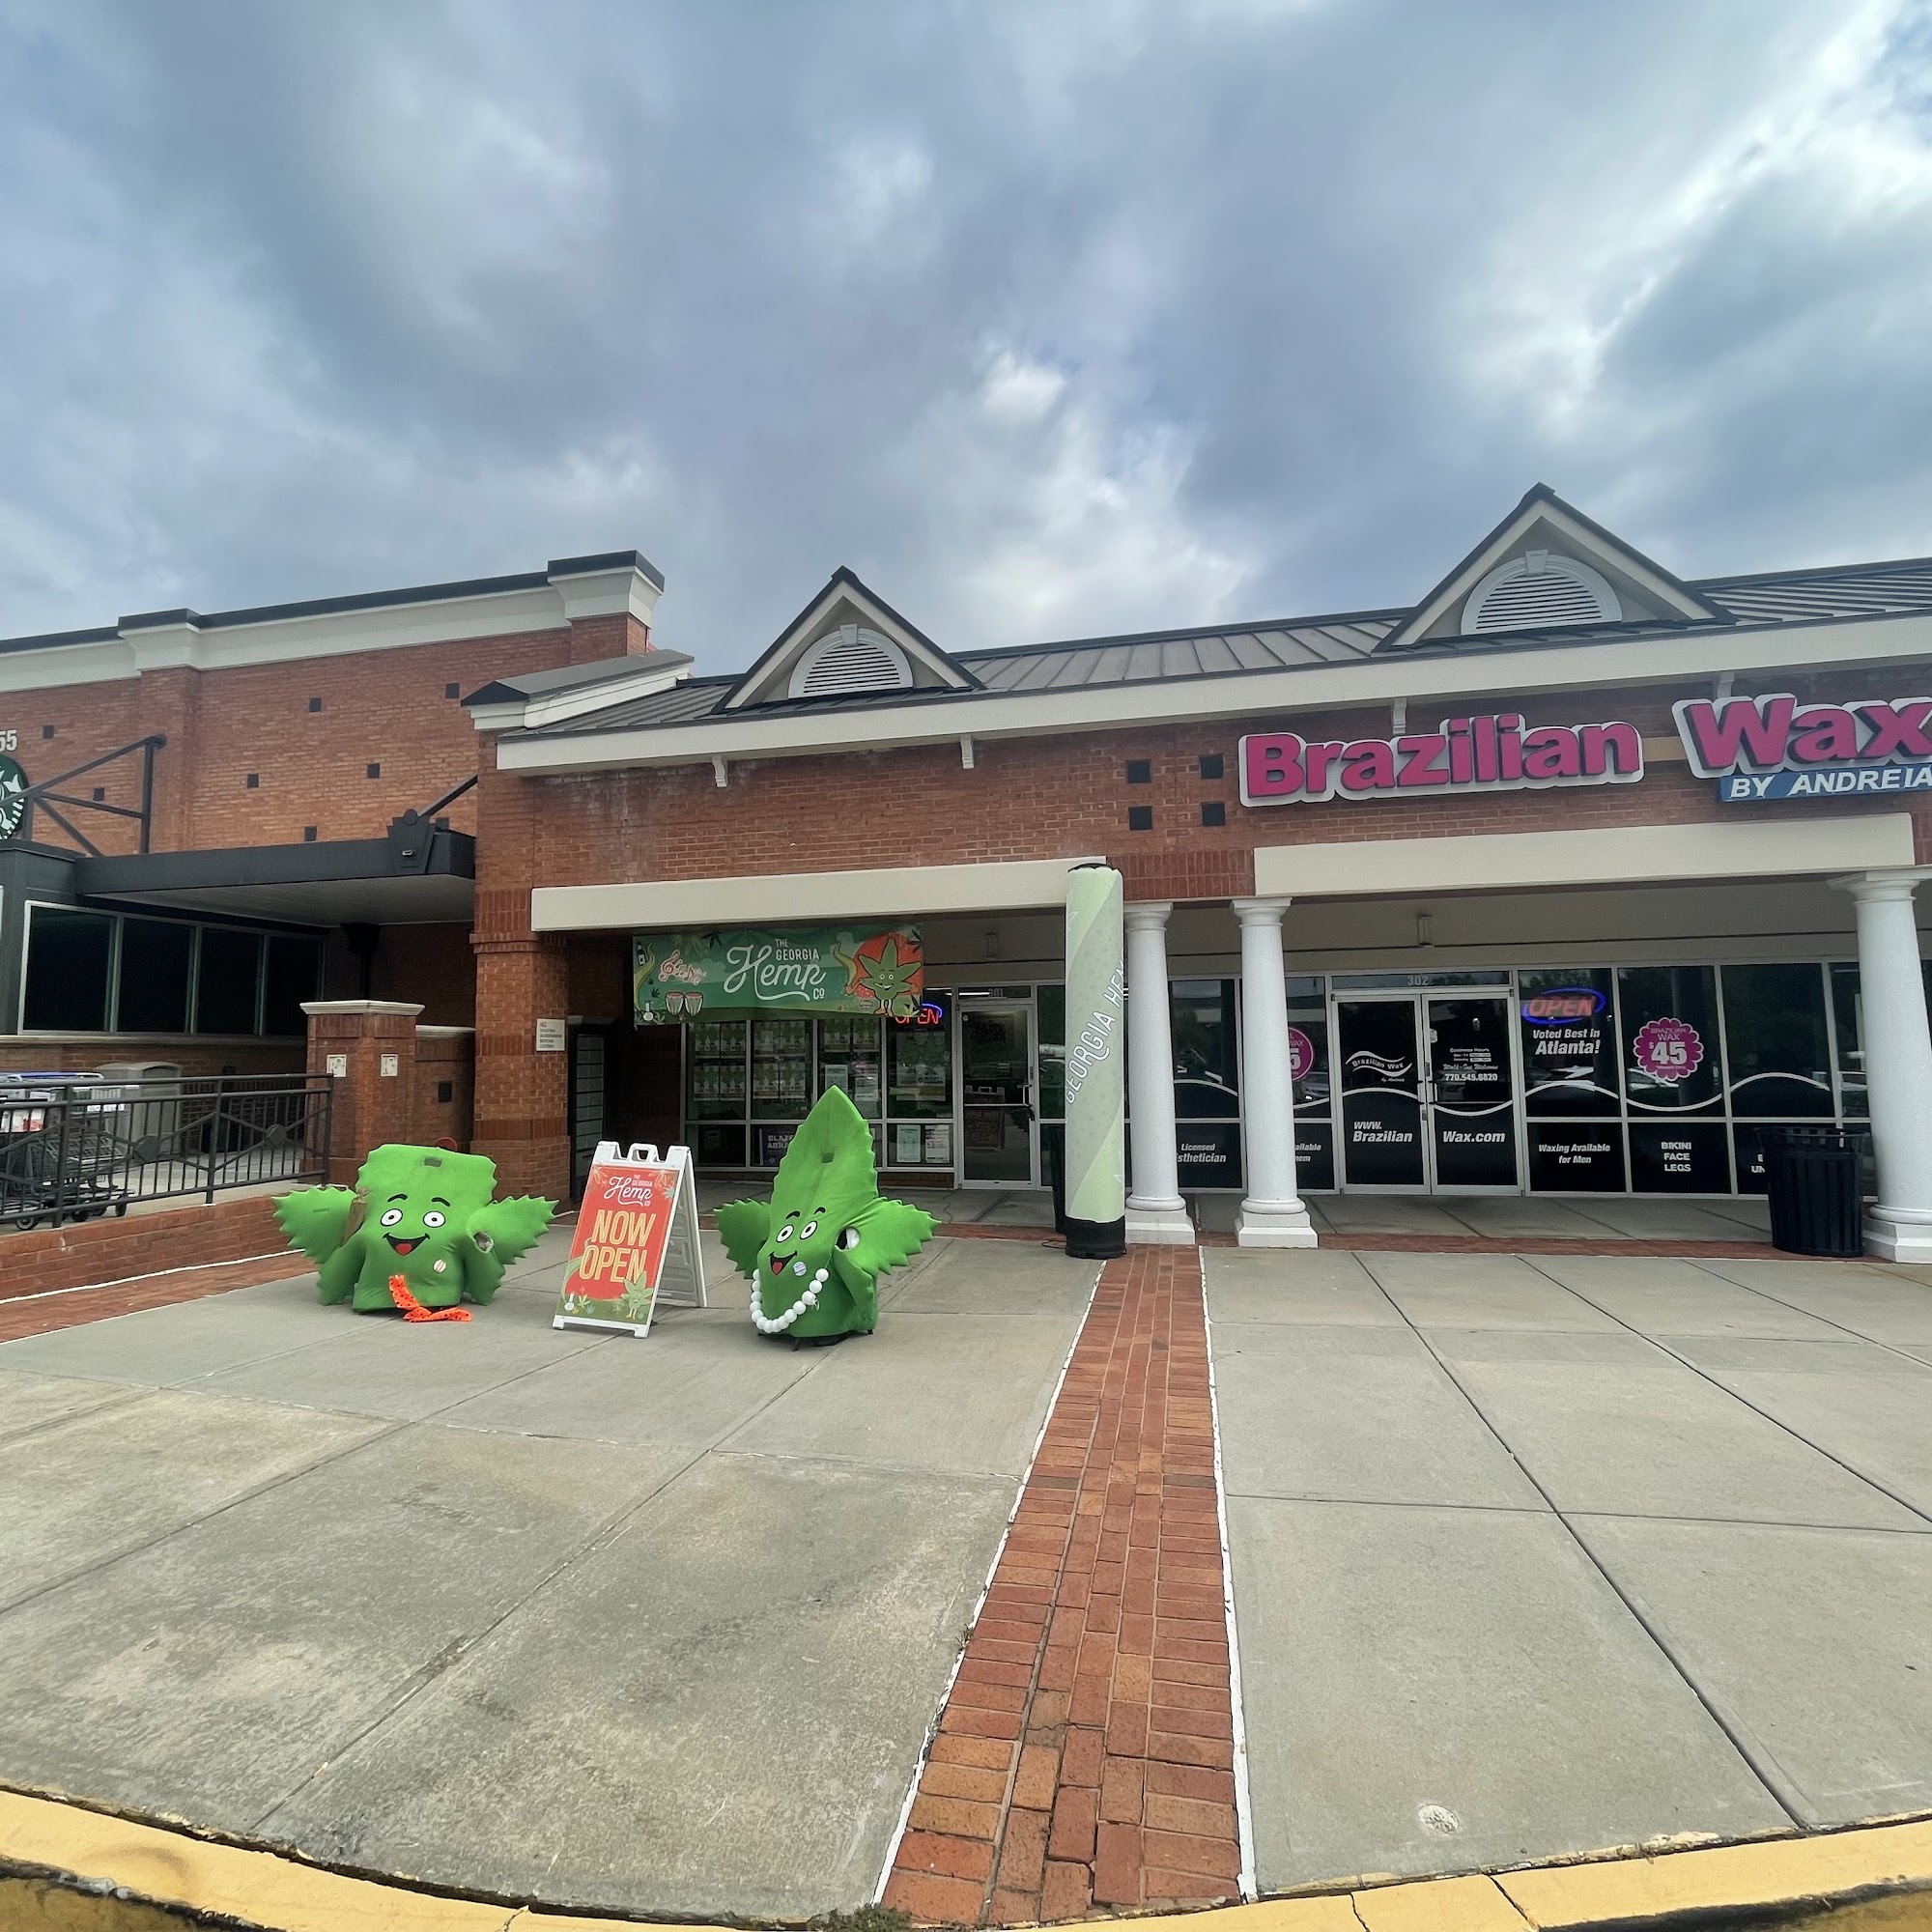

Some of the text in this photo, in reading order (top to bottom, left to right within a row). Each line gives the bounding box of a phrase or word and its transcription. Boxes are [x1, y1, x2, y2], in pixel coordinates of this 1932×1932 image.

[1244, 694, 1932, 801] Brazilian Wax
[1730, 765, 1932, 799] BY ANDREIA
[775, 938, 788, 948] THE
[776, 949, 820, 961] GEORGIA
[724, 944, 827, 1002] Hemp
[1407, 976, 1429, 986] 302
[1528, 995, 1596, 1017] OPEN
[895, 1008, 939, 1024] EN
[1533, 1028, 1601, 1039] Voted Best in
[1657, 1033, 1680, 1041] WAX
[1535, 1039, 1601, 1055] Atlanta!
[1352, 1058, 1405, 1070] Brazilian Wax
[1353, 1122, 1382, 1130] www.
[1352, 1130, 1506, 1143] Brazilian Wax.com
[1180, 1143, 1216, 1151] Licensed
[1294, 1143, 1322, 1151] ailable
[1538, 1143, 1611, 1153] Waxing Available
[1661, 1141, 1692, 1151] BIKINI
[1176, 1152, 1227, 1163] sthetician
[1558, 1154, 1572, 1164] for
[1663, 1152, 1691, 1161] FACE
[1663, 1163, 1692, 1172] LEGS
[603, 1175, 654, 1208] Hemp
[590, 1209, 657, 1247] NOW
[579, 1244, 648, 1285] OPEN
